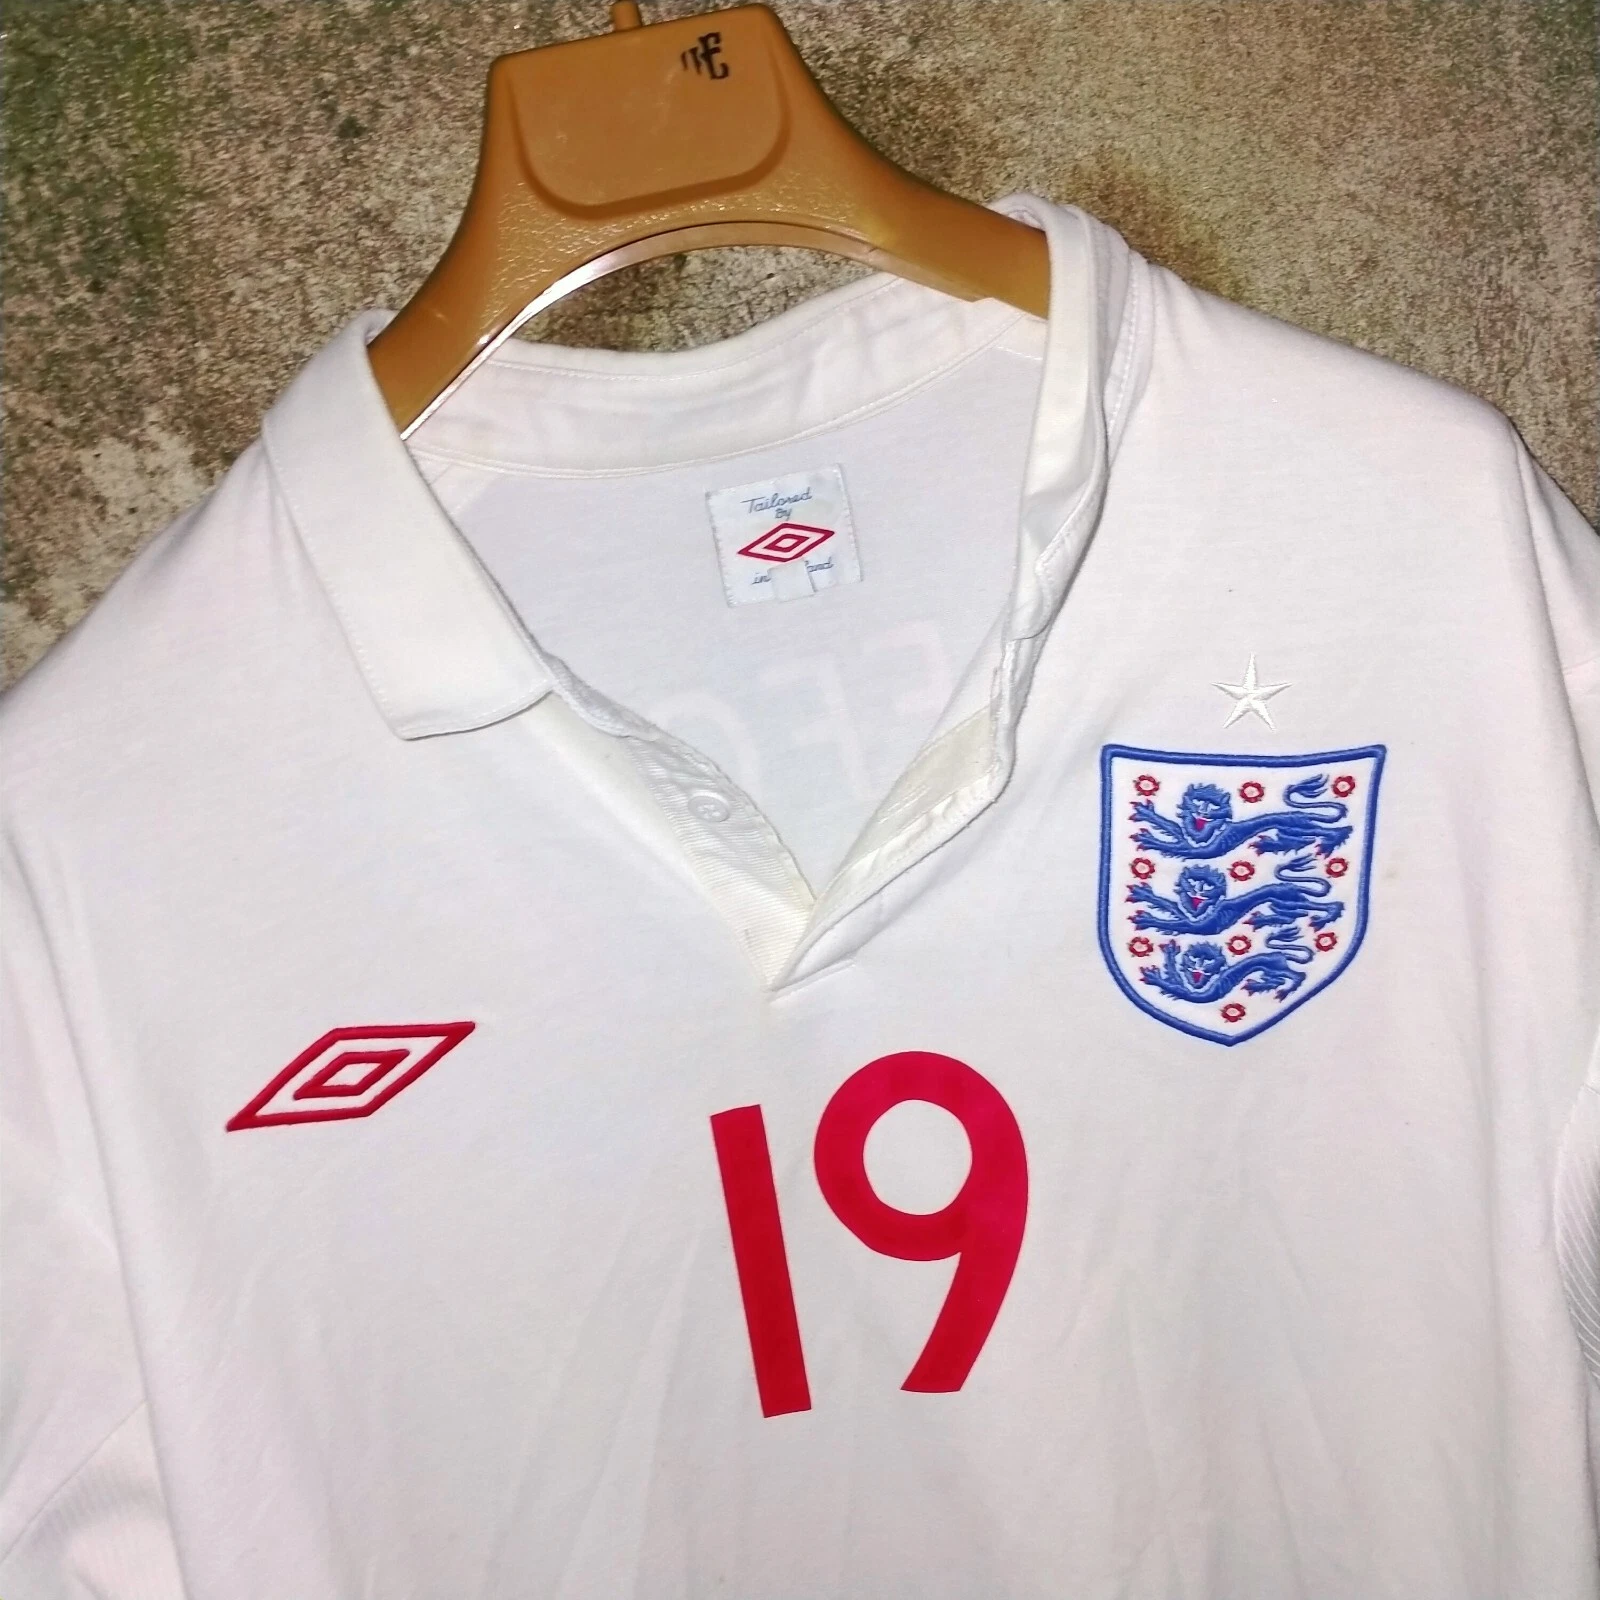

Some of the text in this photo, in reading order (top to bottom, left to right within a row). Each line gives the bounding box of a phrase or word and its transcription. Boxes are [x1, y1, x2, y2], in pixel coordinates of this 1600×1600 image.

[740, 487, 813, 514] Tailored
[774, 507, 792, 521] By
[710, 1051, 1029, 1418] 19
